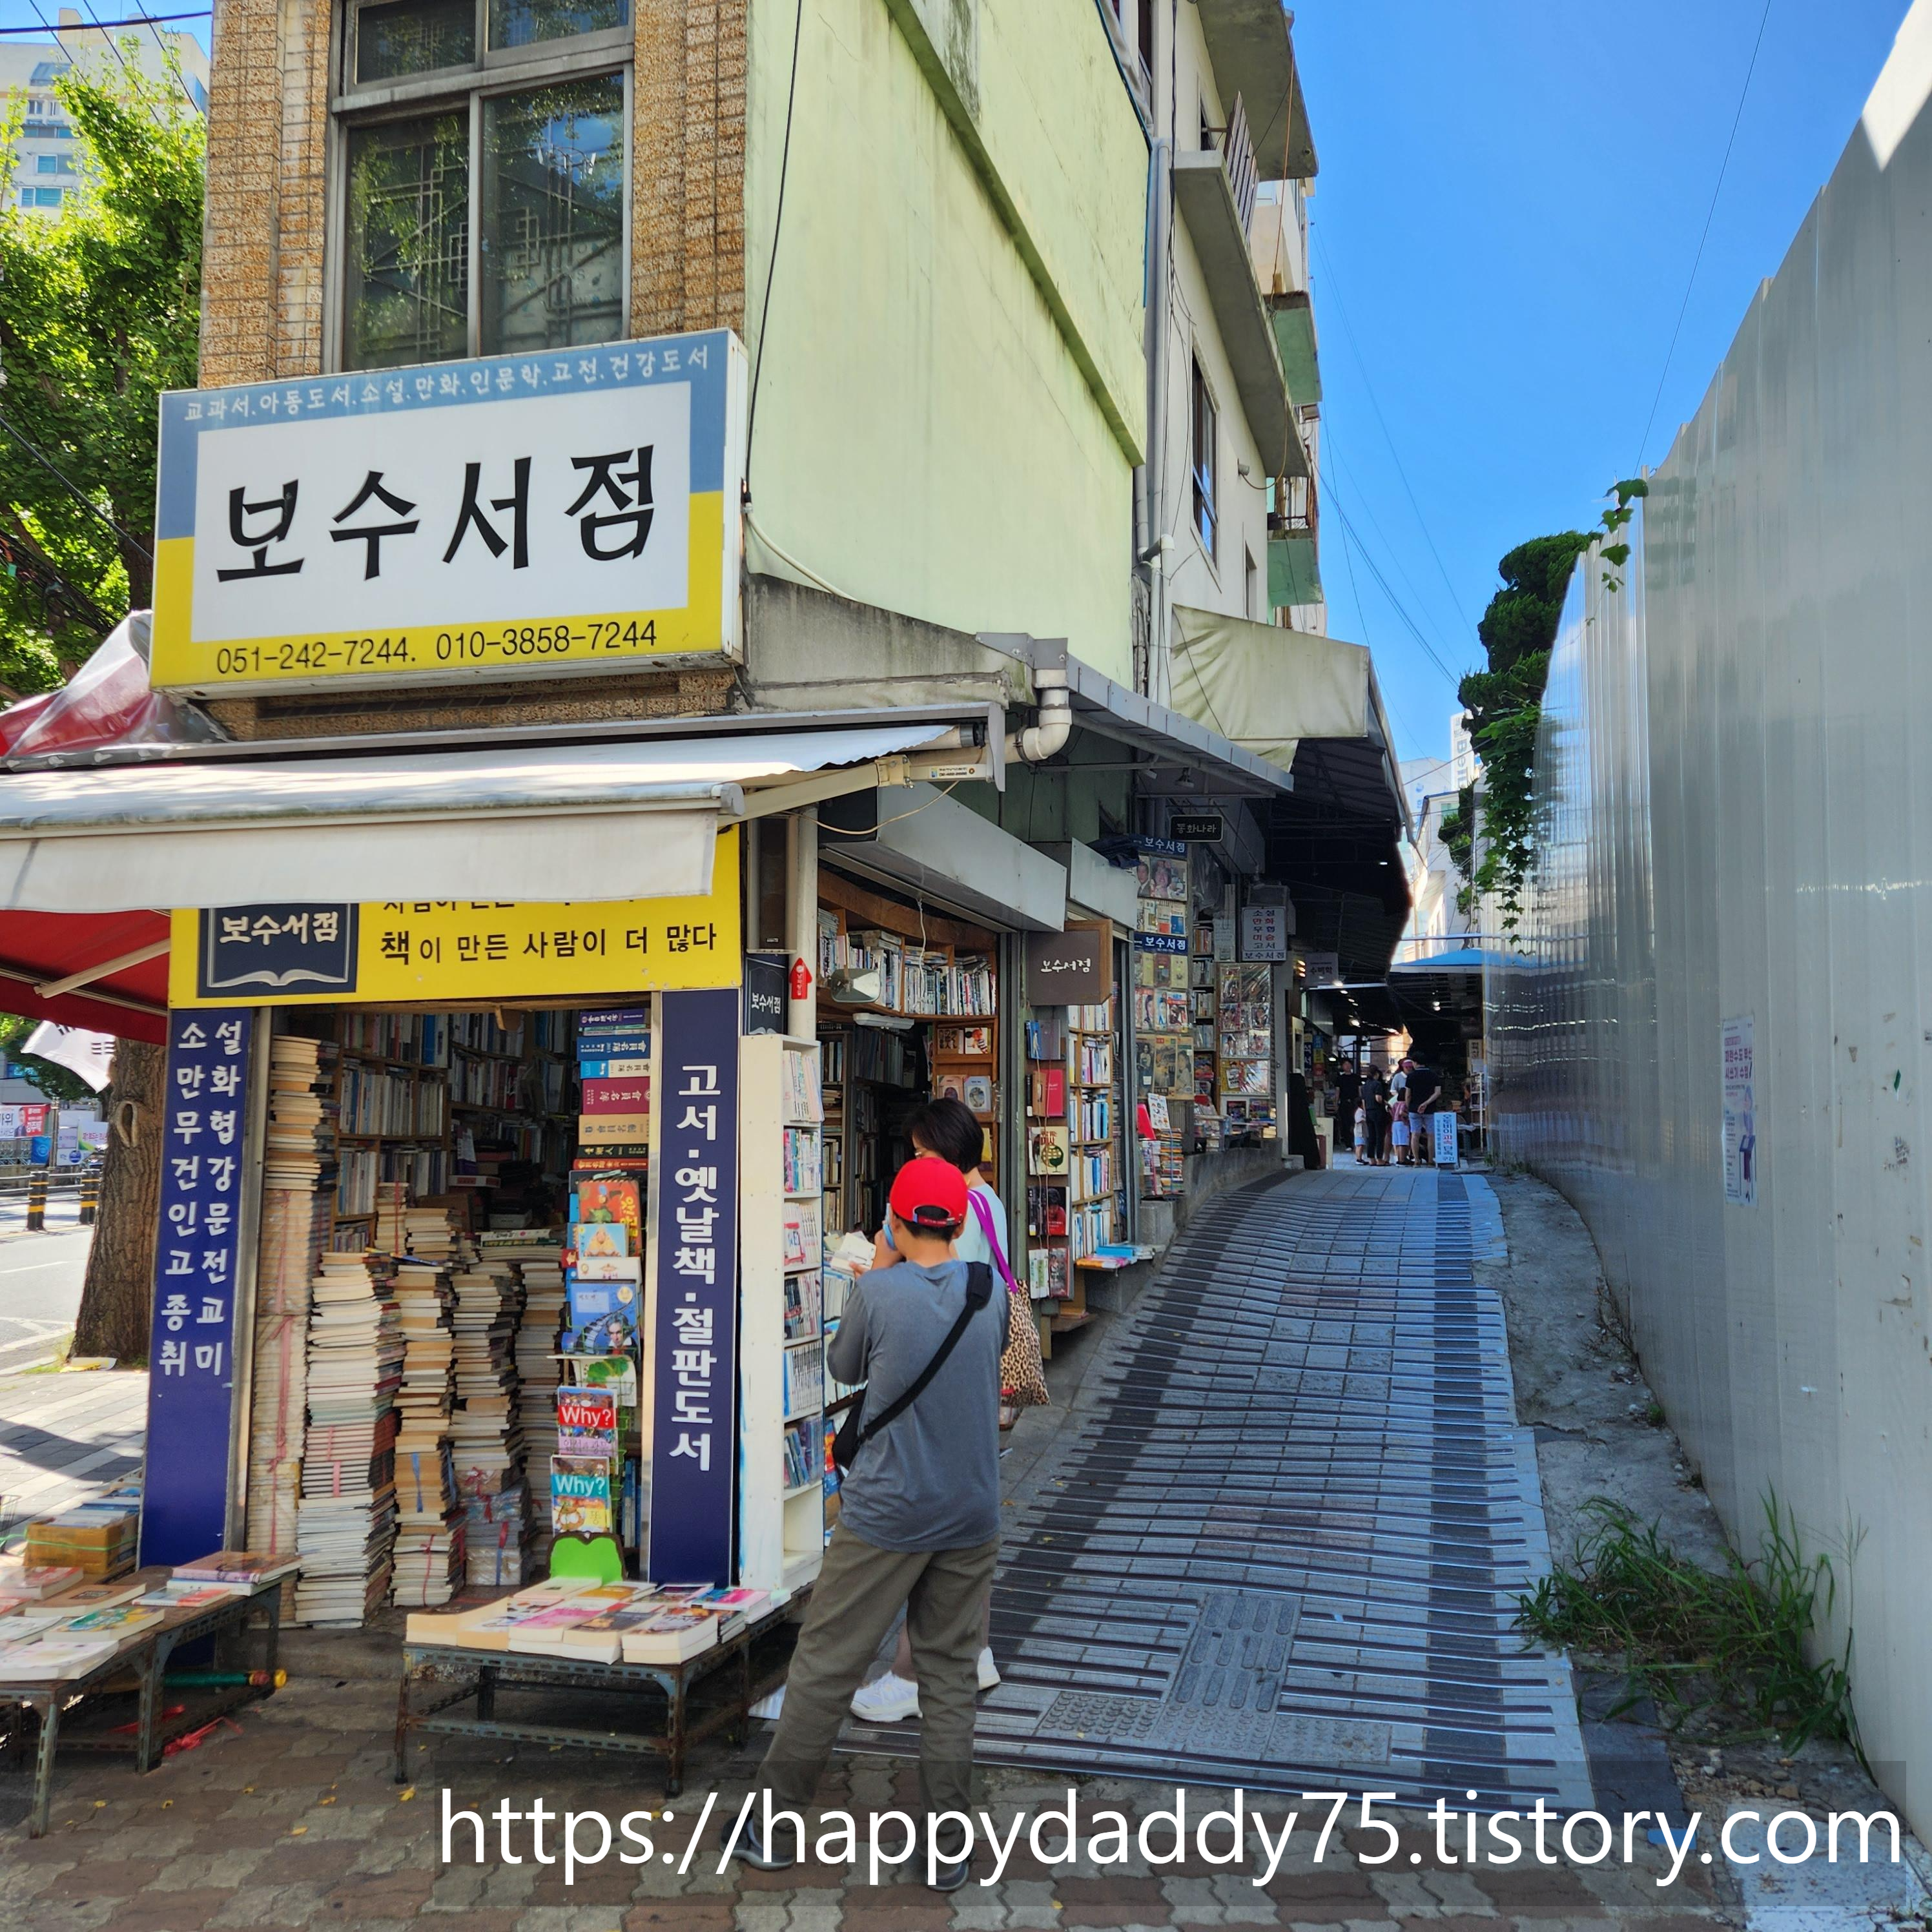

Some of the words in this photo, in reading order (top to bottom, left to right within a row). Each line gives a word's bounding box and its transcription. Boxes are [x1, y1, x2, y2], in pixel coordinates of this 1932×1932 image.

[216, 444, 655, 582] 보수서점
[436, 619, 657, 661] 010-3858-7244
[1144, 837, 1186, 854] 보수서점
[218, 910, 340, 946] 보수서점
[380, 930, 441, 967] 책이
[457, 933, 509, 963] 만든
[522, 928, 606, 958] 사람이
[625, 926, 648, 955] 더
[666, 921, 717, 952] 많다
[1144, 936, 1186, 951] 보수서점
[1040, 958, 1092, 974] 보수서점
[1244, 951, 1285, 960] 보수서점
[751, 992, 781, 1015] 보수서점
[560, 1405, 612, 1428] Why?
[555, 1475, 606, 1496] Why?
